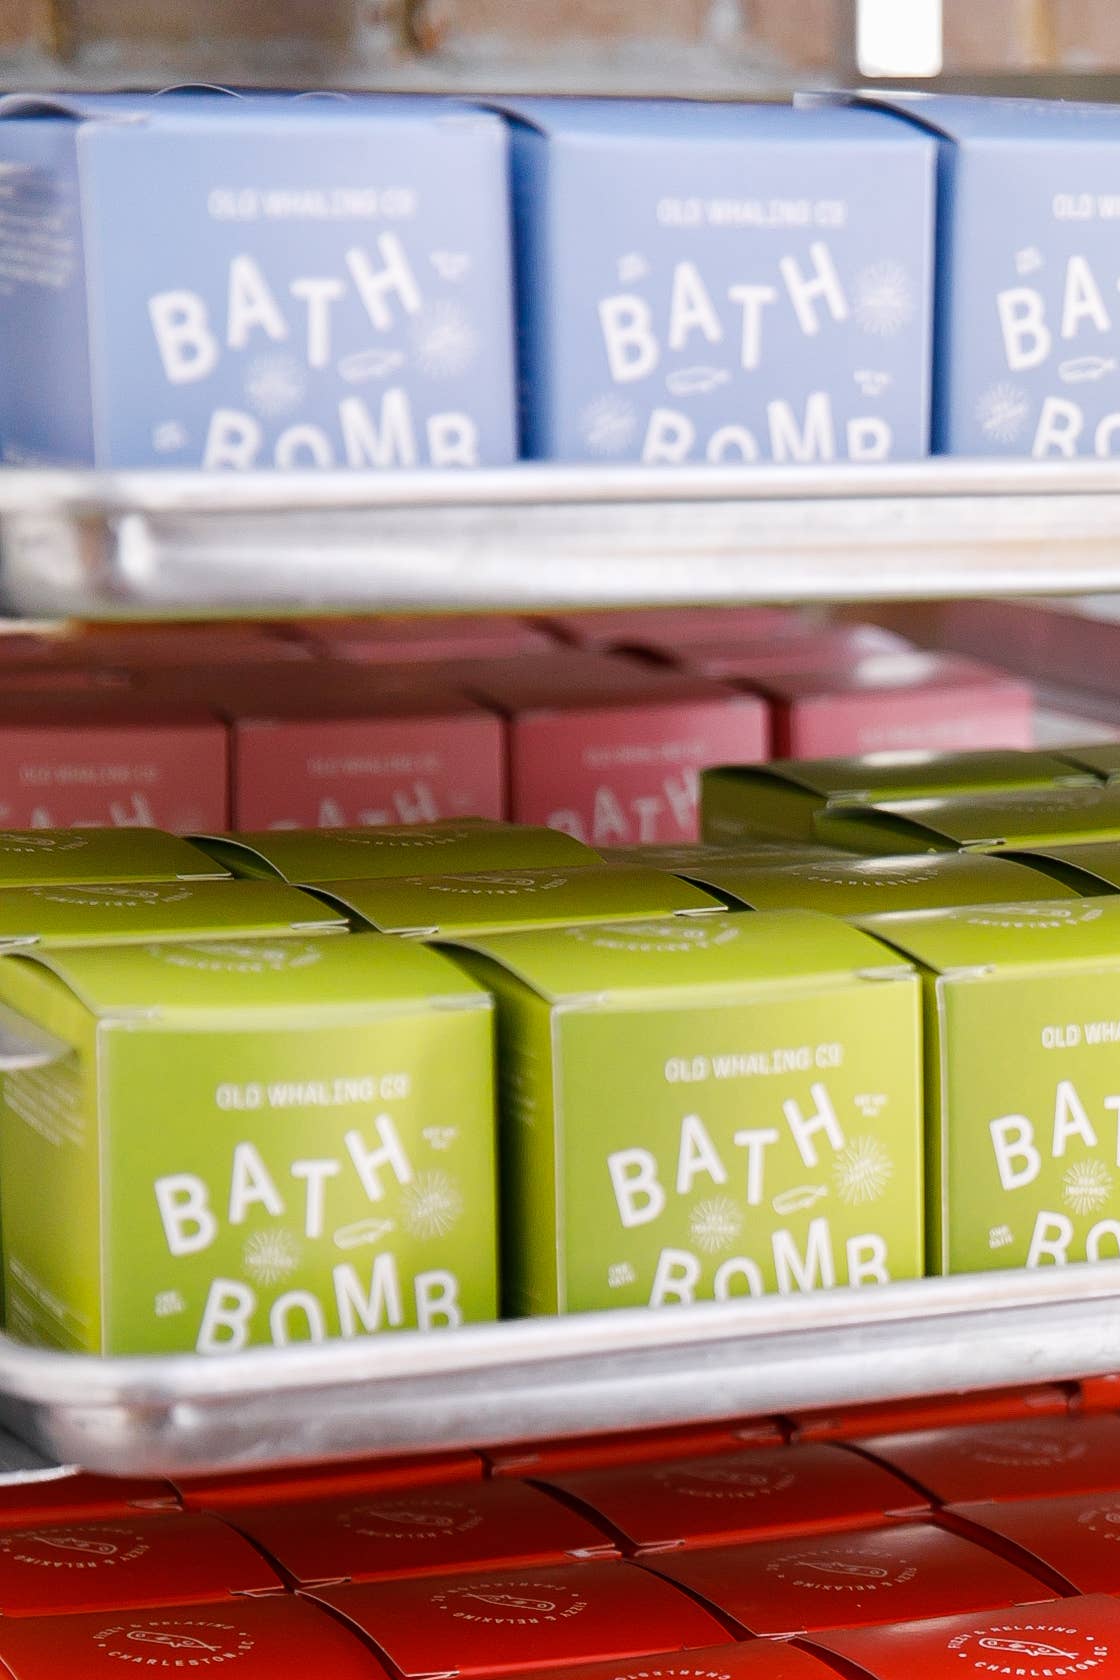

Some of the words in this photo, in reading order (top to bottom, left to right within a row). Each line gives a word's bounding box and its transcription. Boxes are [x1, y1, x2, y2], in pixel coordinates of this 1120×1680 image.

[147, 232, 421, 385] BATH
[599, 241, 847, 383] BATH
[664, 1057, 708, 1083] OLD
[713, 1049, 811, 1078] WHALING
[1041, 1026, 1080, 1048] OLD
[216, 1081, 261, 1110] OLD
[267, 1077, 375, 1108] WHALING
[154, 1113, 413, 1257] BATH
[607, 1082, 845, 1228] BATH
[196, 1252, 462, 1353] BOMB
[948, 1634, 972, 1649] FIZZY
[990, 1625, 1078, 1634] RELAXING
[1094, 1646, 1108, 1656] SC
